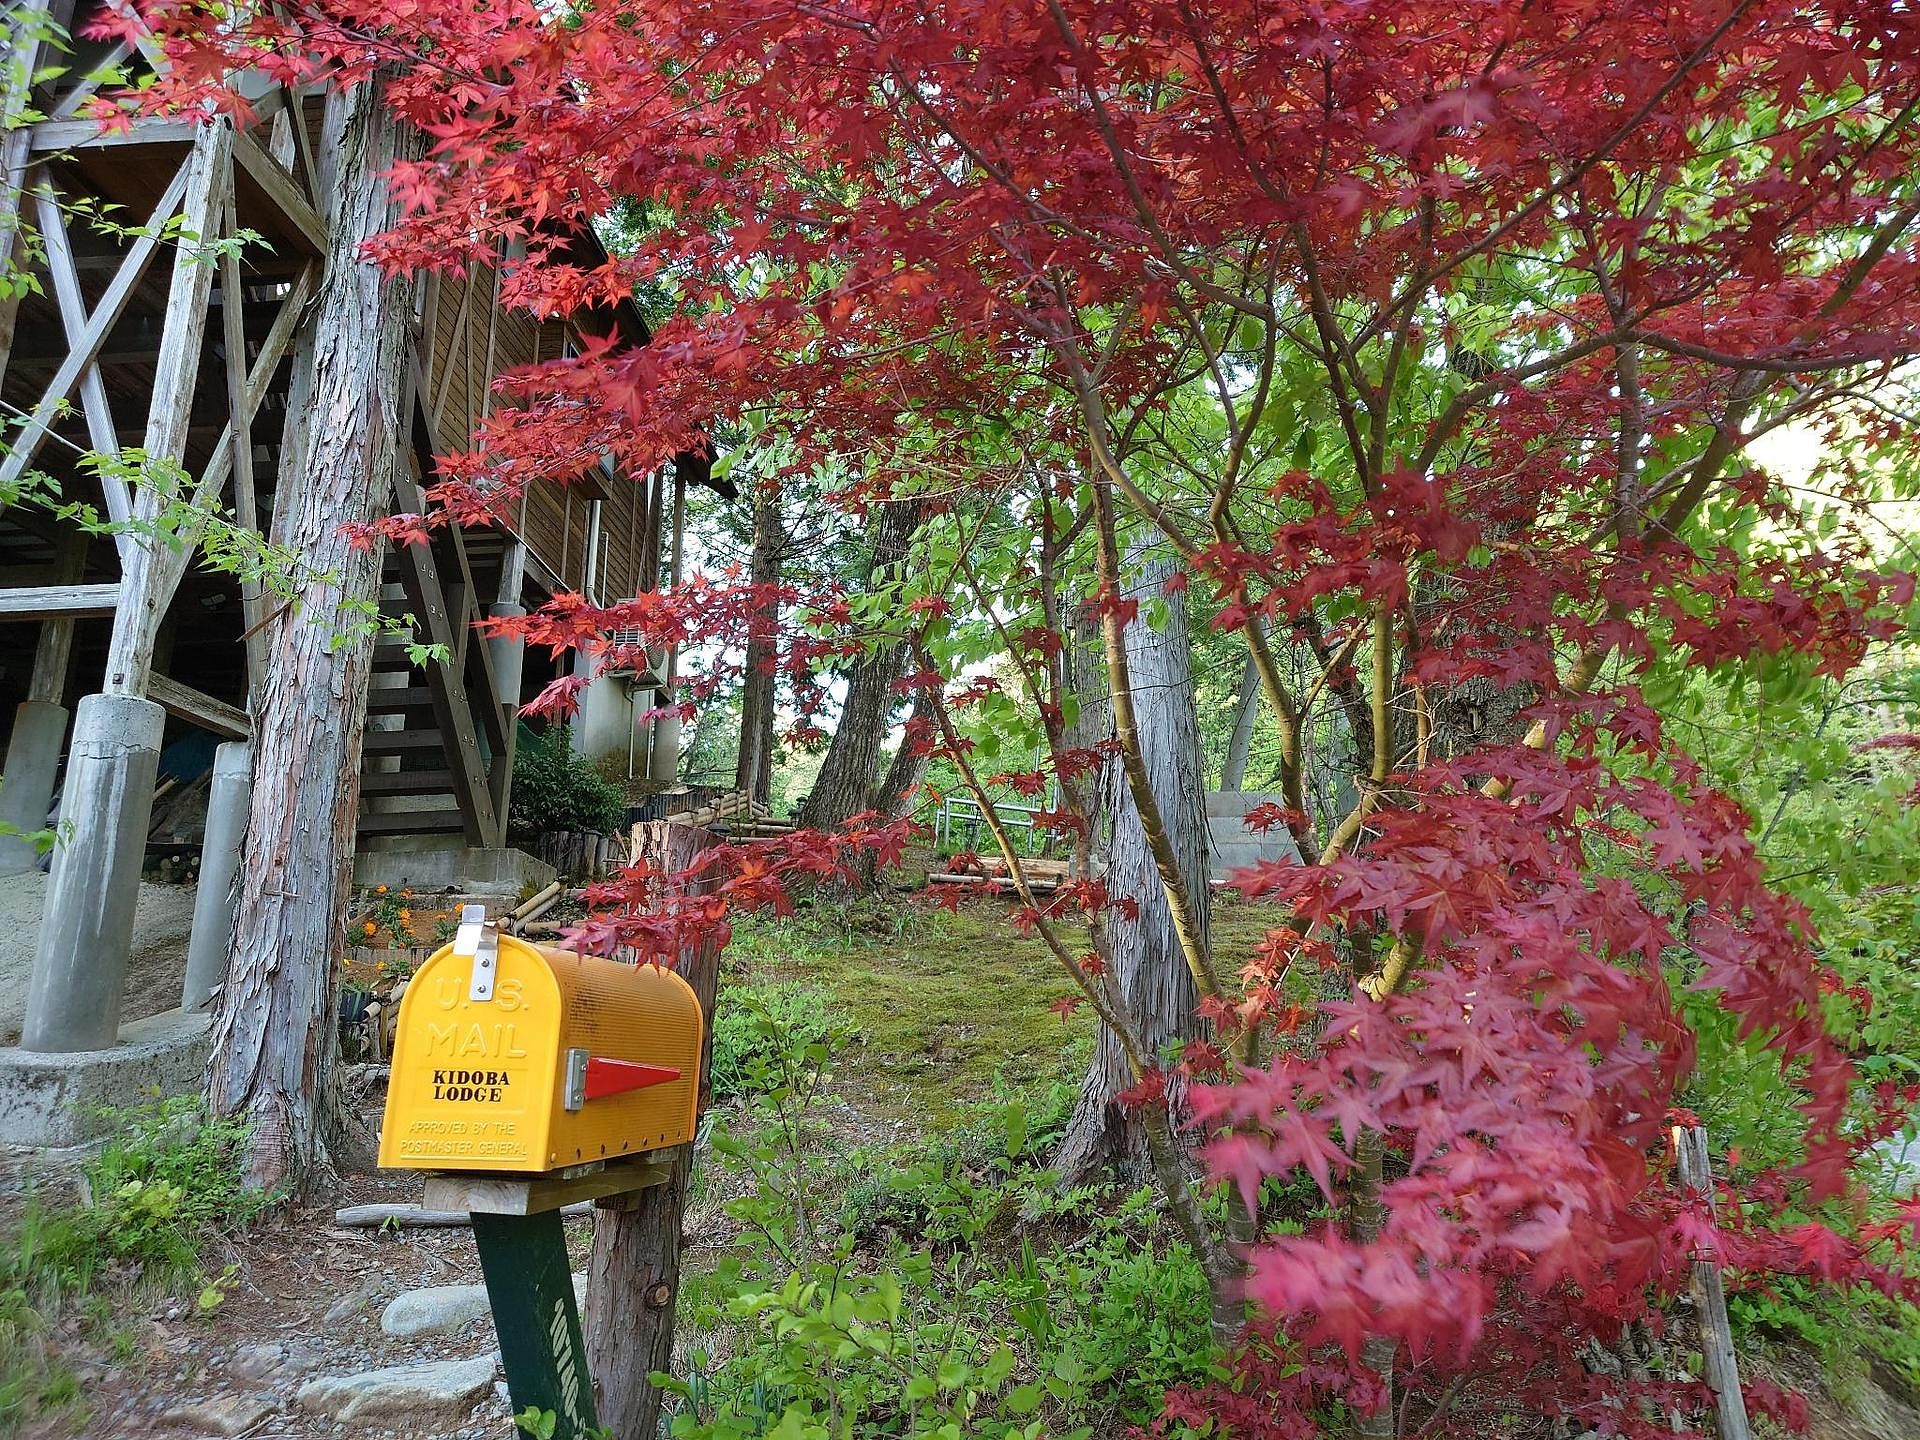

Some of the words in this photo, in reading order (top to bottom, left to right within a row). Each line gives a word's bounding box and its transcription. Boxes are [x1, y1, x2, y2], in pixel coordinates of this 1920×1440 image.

[426, 1022, 528, 1058] MAIL
[432, 1070, 510, 1085] KIDOBA
[434, 1086, 503, 1102] LODGE
[408, 1121, 468, 1135] APPROVED
[473, 1121, 488, 1135] BY
[494, 1121, 516, 1135] THE
[401, 1140, 474, 1154] POSTMASTER
[479, 1141, 527, 1156] GENERAL
